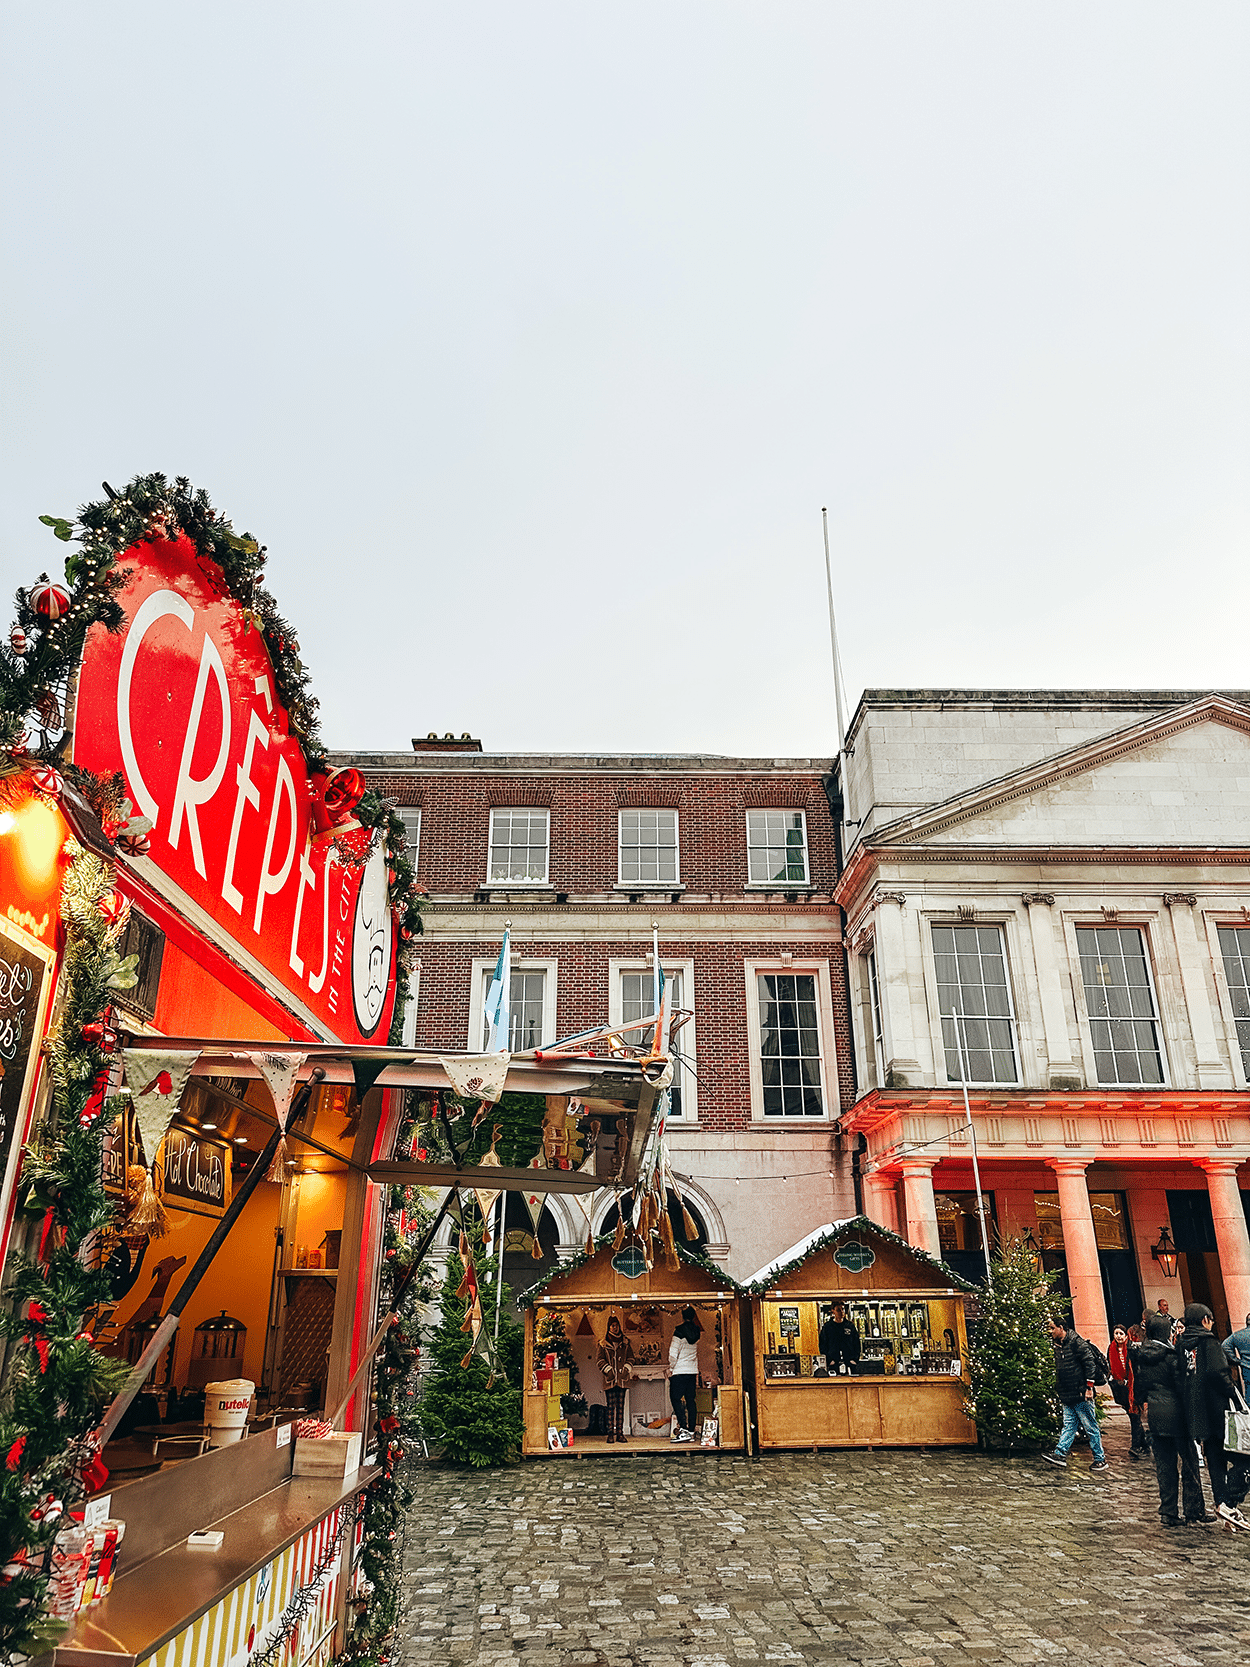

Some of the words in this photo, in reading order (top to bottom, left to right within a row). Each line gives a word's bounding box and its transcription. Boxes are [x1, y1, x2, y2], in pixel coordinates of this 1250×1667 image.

[339, 868, 353, 922] CITY
[331, 928, 346, 977] THE
[328, 985, 339, 1014] IN
[164, 1131, 187, 1186] Hot
